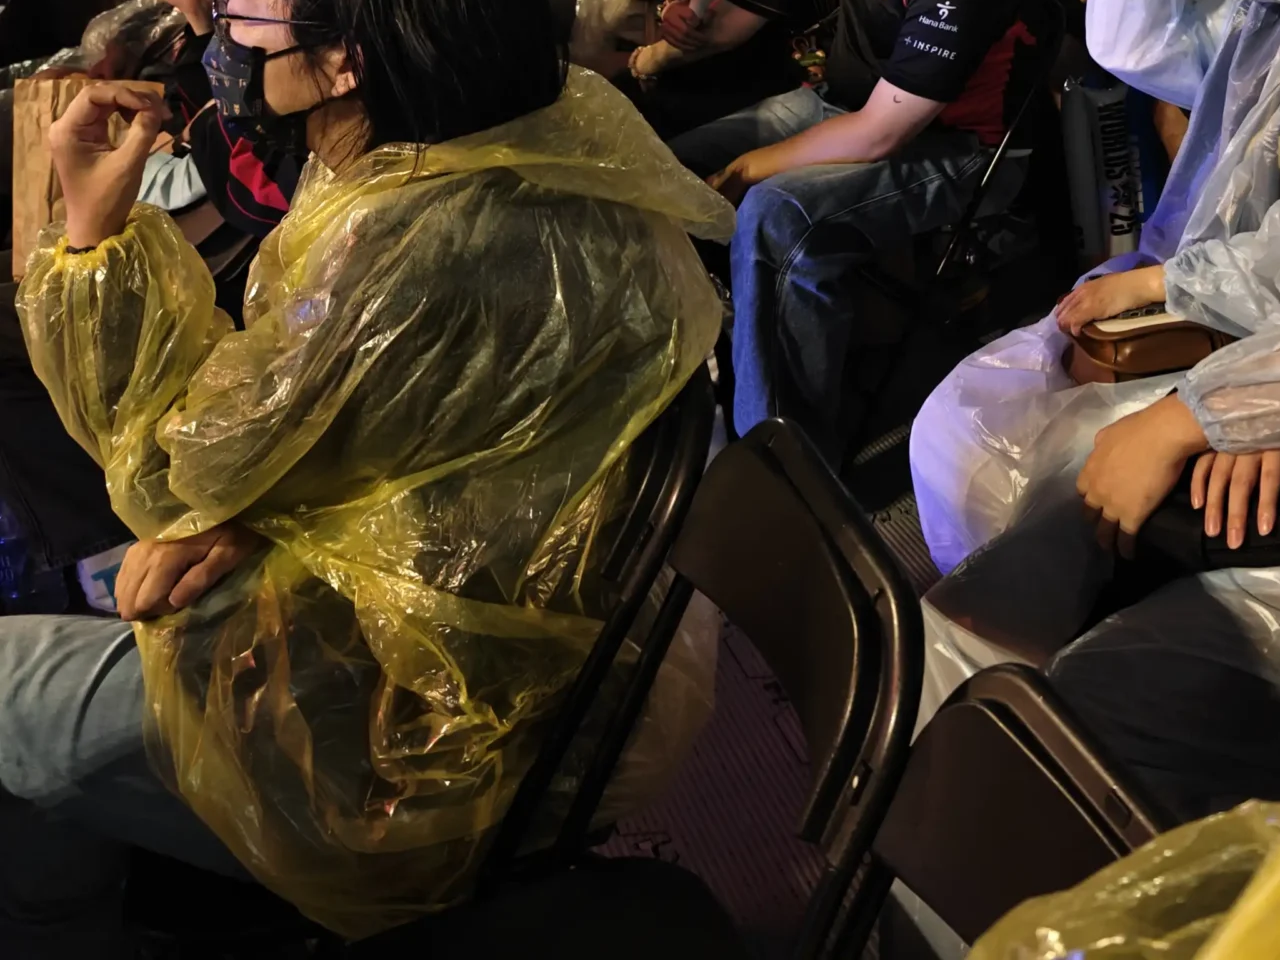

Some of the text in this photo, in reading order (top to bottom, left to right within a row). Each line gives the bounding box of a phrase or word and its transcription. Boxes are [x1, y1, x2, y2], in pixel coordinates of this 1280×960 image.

[918, 15, 959, 33] Hana Bank
[913, 39, 957, 60] INSPIRE
